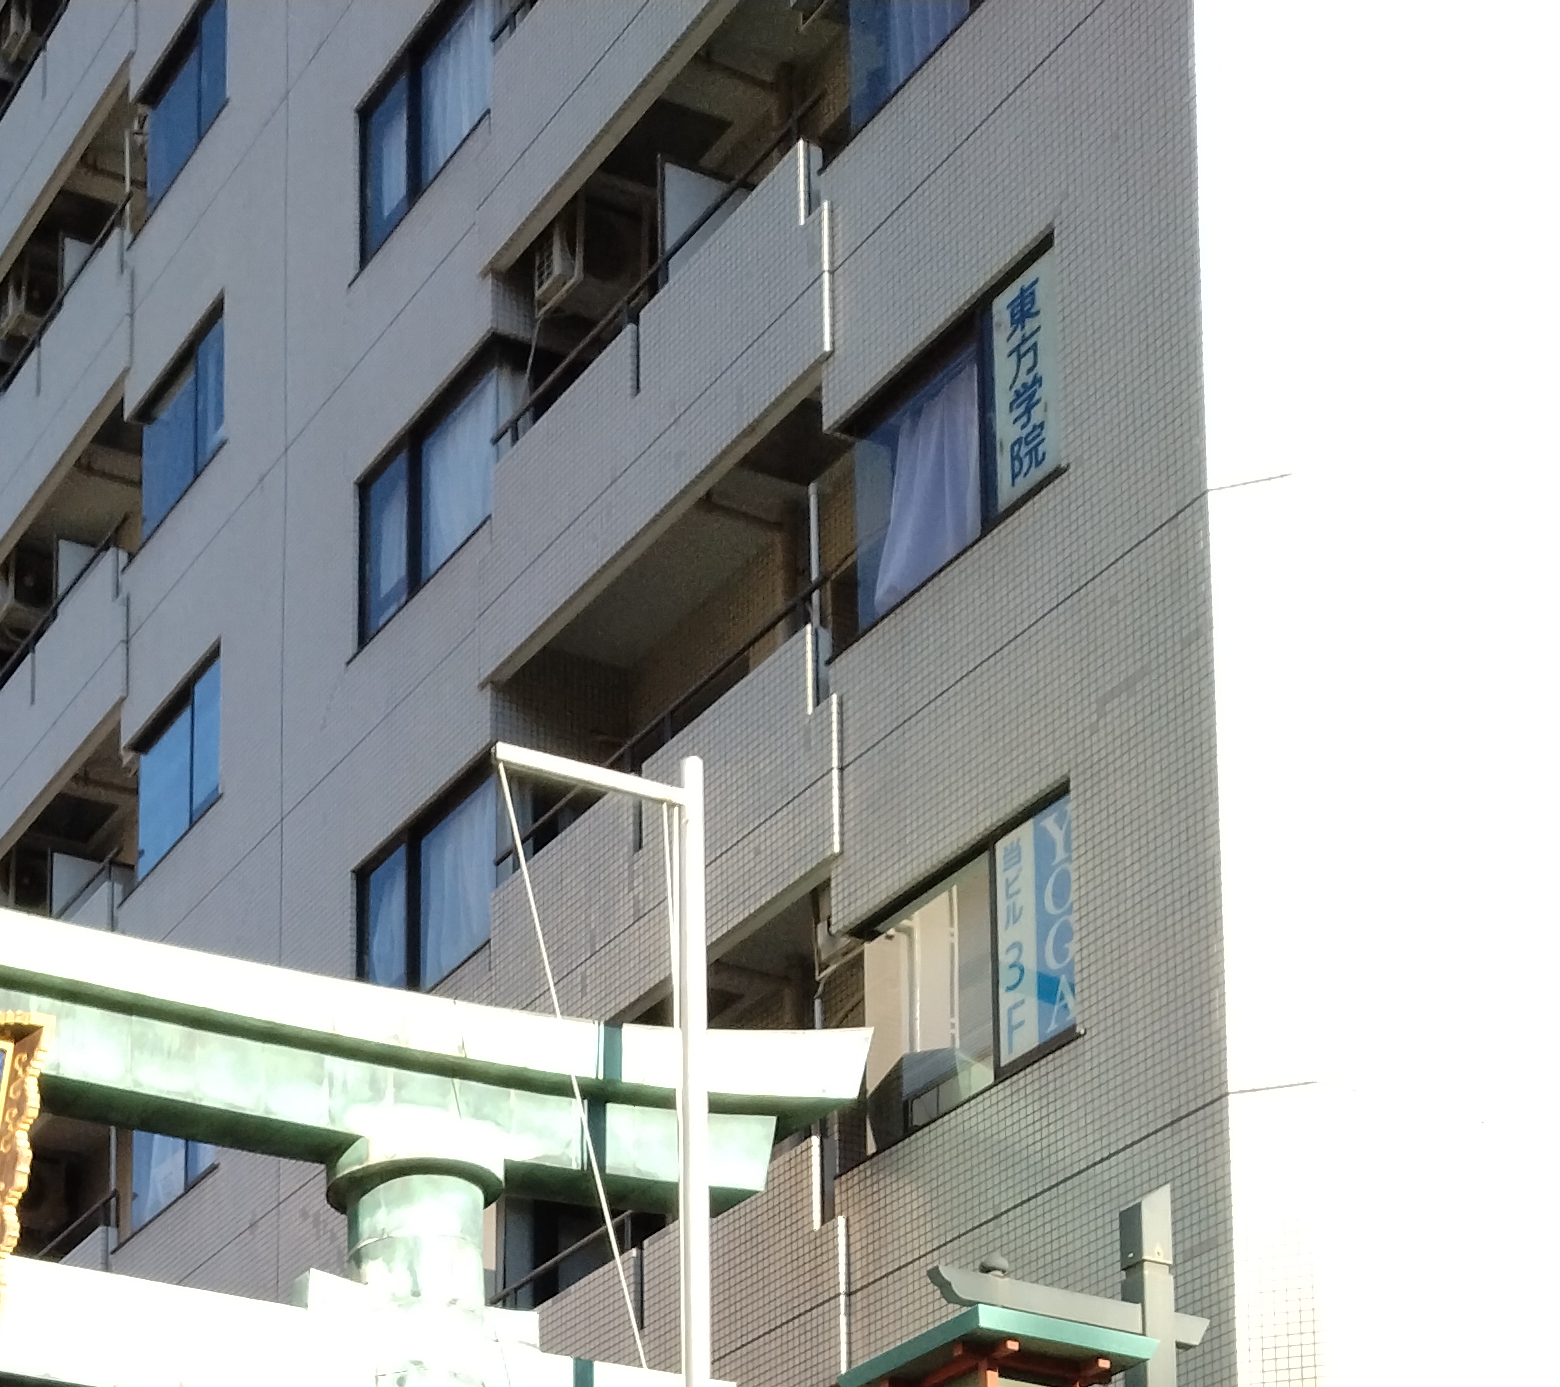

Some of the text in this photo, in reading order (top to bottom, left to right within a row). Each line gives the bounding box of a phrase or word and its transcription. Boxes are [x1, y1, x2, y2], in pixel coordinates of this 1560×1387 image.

[1006, 277, 1047, 488] 東方学院
[1040, 808, 1076, 1034] YOGA
